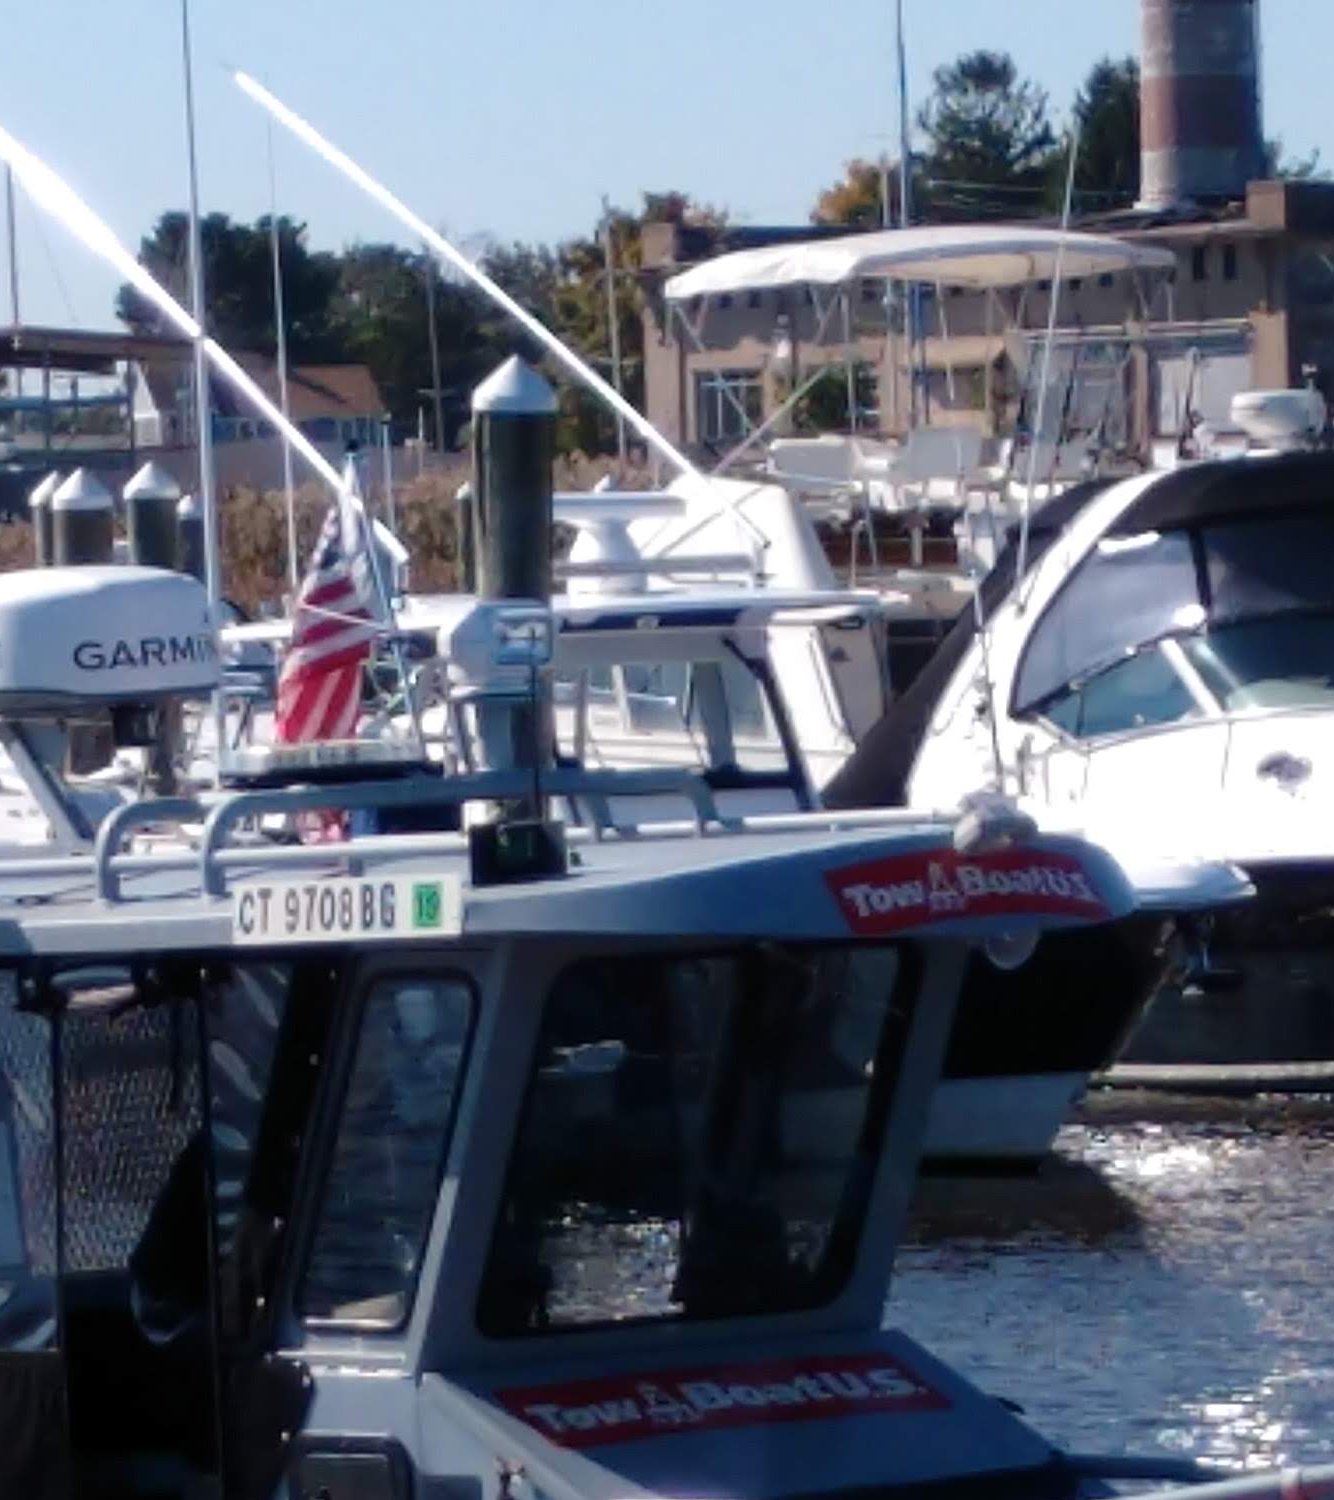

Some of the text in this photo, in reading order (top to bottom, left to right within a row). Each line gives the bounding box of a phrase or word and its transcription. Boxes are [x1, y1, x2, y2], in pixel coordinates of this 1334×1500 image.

[239, 887, 272, 935] CT
[284, 884, 353, 933] 9708
[842, 880, 924, 918] Tow
[524, 1399, 641, 1432] Tow
